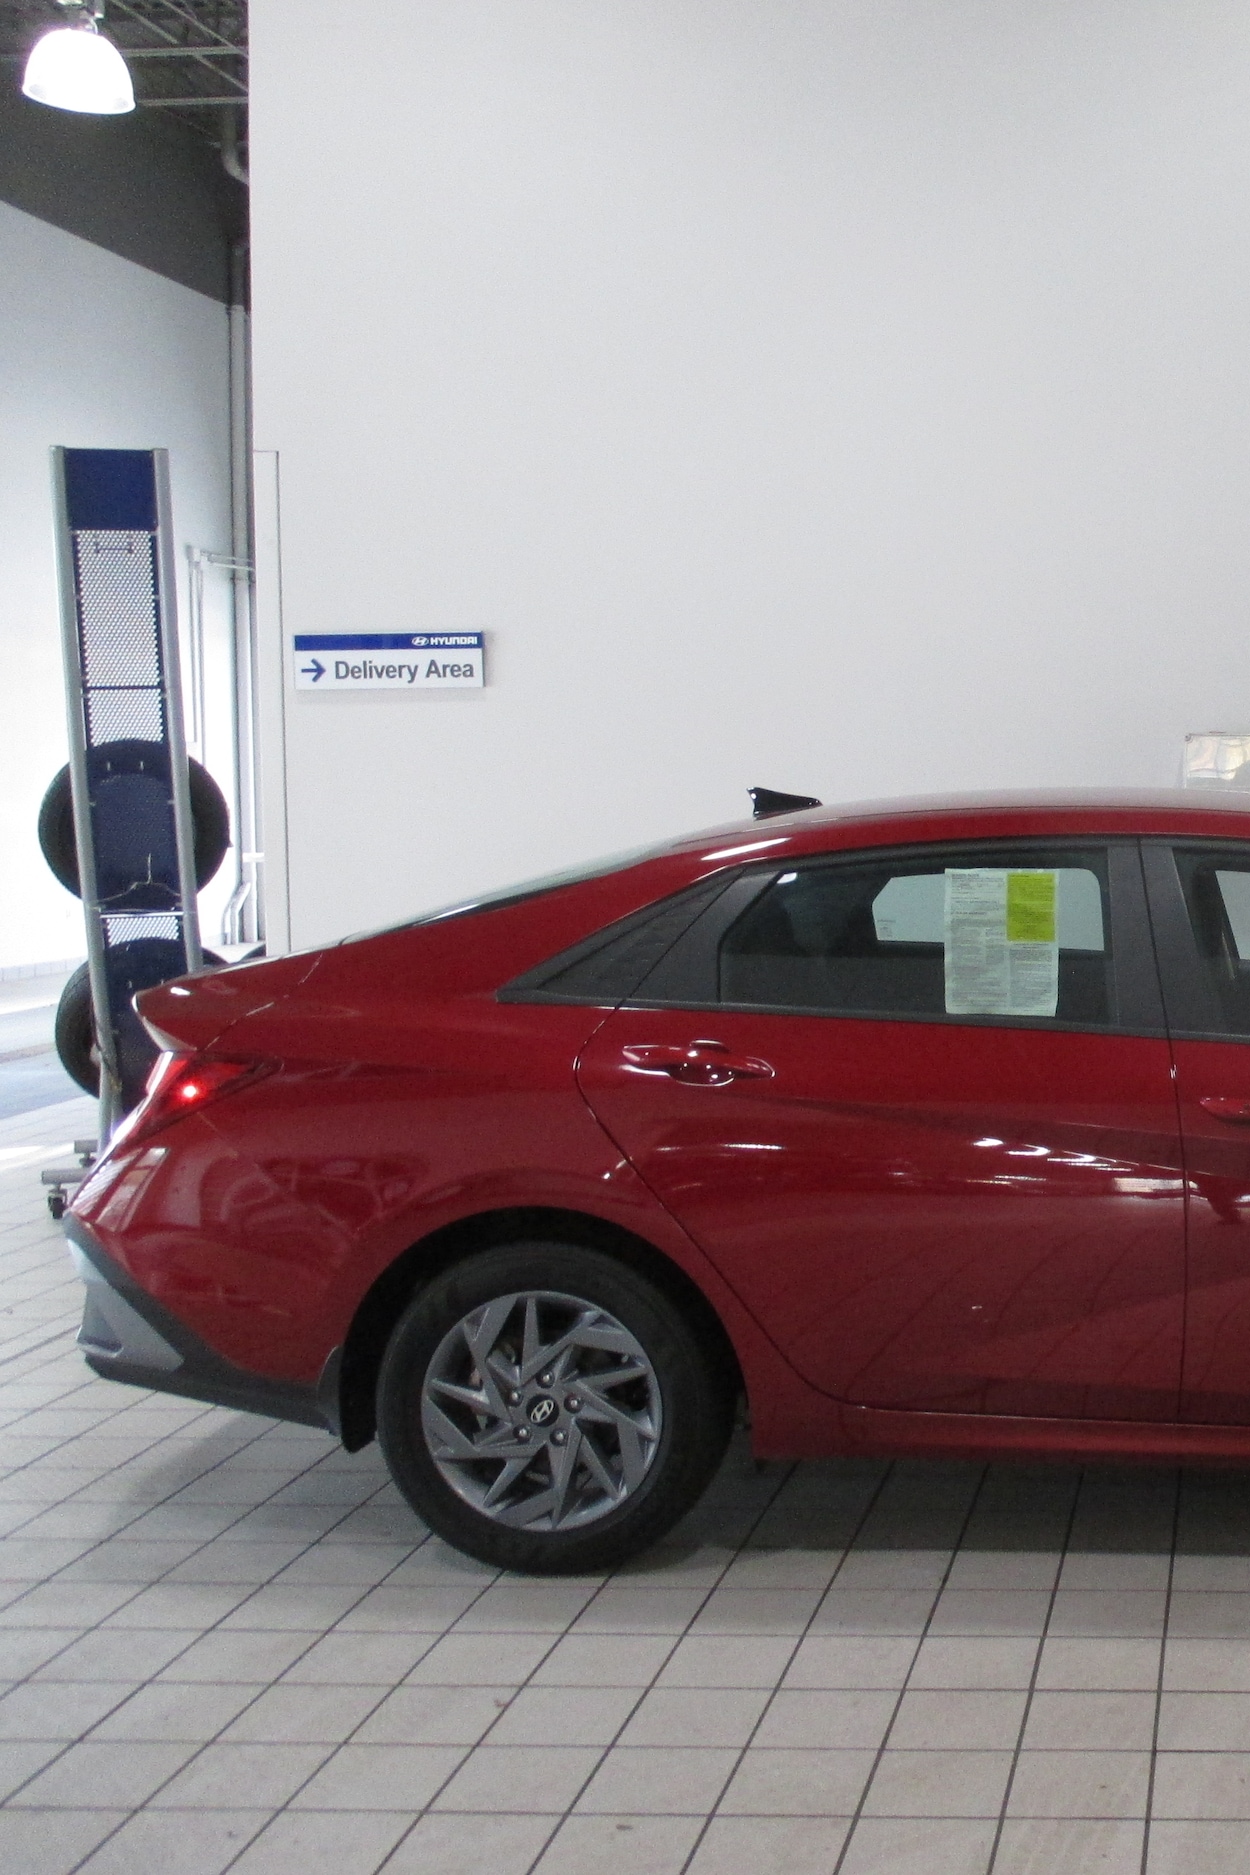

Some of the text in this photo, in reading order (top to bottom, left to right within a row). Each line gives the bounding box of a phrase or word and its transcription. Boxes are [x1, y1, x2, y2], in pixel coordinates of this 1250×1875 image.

[430, 636, 478, 646] HYUNDAI
[334, 659, 475, 684] Delivery Area
